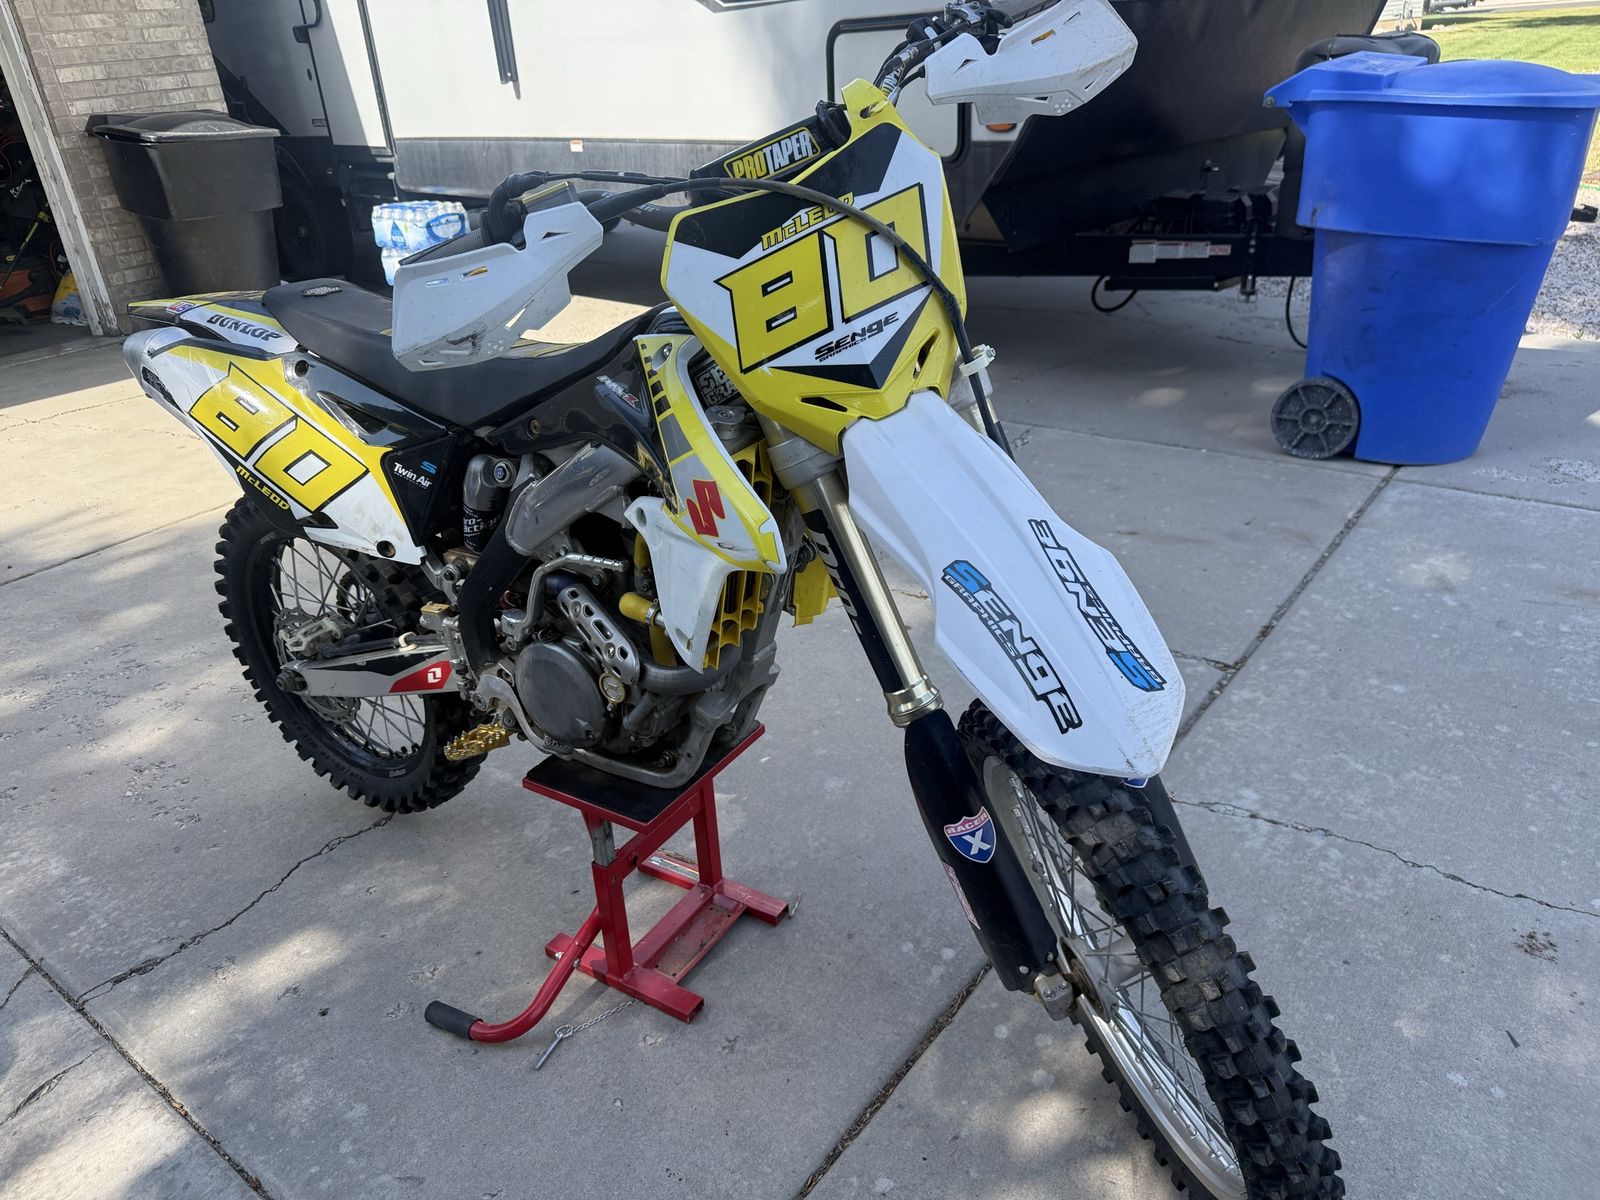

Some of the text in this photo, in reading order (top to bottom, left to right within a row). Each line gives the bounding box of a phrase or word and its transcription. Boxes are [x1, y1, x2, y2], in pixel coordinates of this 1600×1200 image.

[713, 182, 932, 374] 80
[206, 313, 284, 342] DUNLOP
[188, 361, 370, 514] 80
[235, 465, 291, 511] McLEOD
[394, 462, 418, 481] Twin
[418, 475, 433, 489] Air
[943, 574, 1018, 656] GRAPHICS
[946, 812, 989, 835] RACER
[961, 828, 992, 856] X
